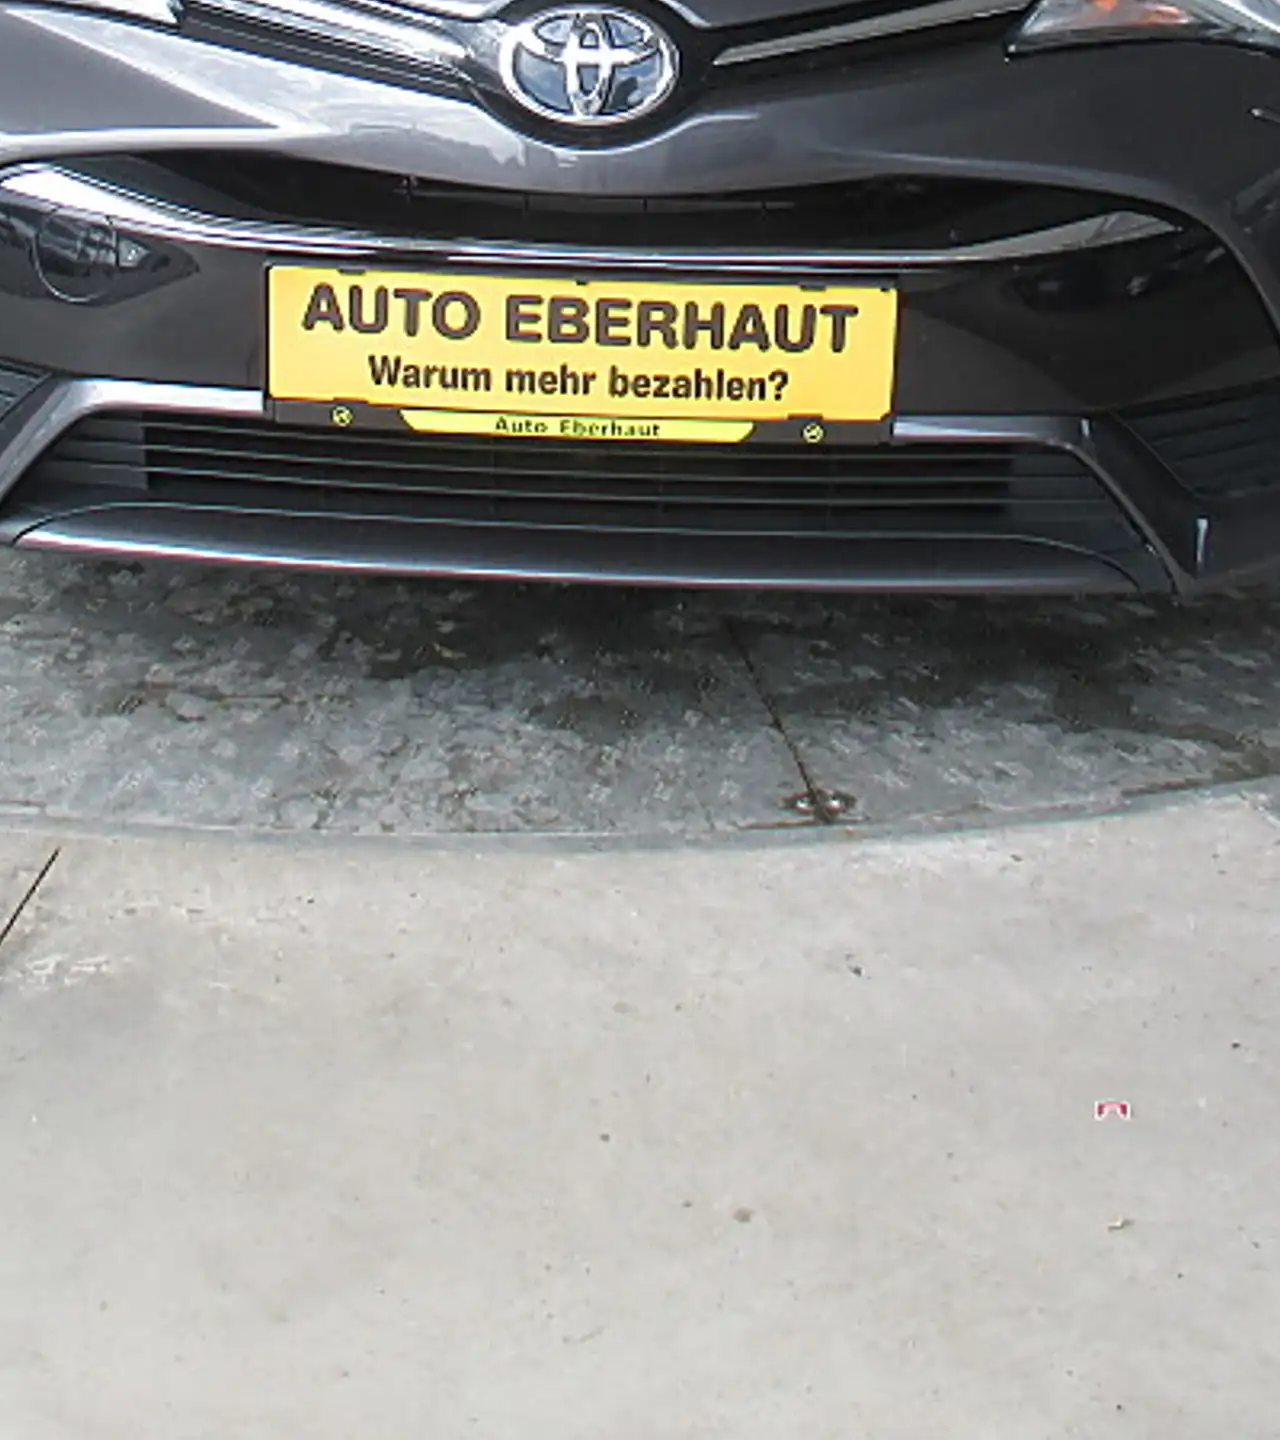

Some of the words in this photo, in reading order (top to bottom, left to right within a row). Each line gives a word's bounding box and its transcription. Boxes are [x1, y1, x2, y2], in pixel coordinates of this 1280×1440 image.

[301, 281, 482, 340] AUTO
[504, 293, 860, 353] EBERHAUT
[368, 354, 492, 391] Warum
[505, 363, 597, 396] mehr
[607, 364, 789, 401] bezahlen?
[494, 415, 549, 434] Auto
[559, 418, 661, 438] Eberhaut
